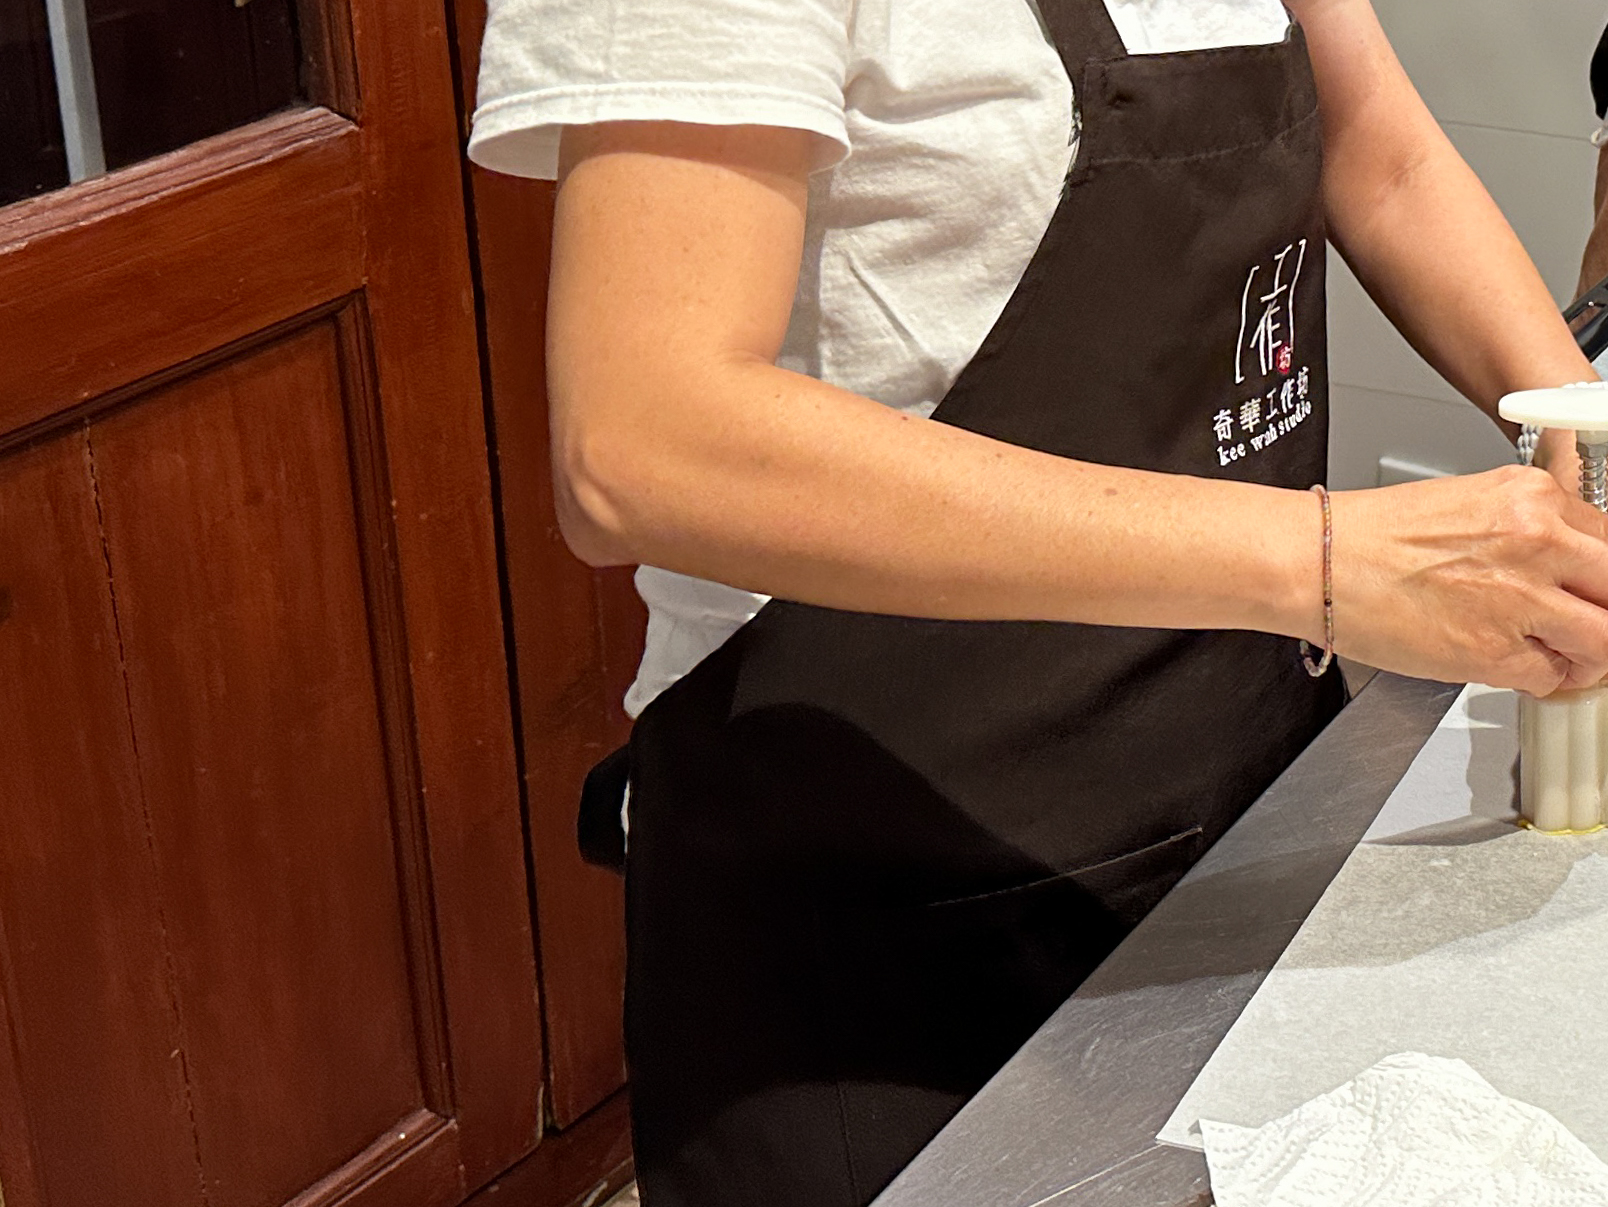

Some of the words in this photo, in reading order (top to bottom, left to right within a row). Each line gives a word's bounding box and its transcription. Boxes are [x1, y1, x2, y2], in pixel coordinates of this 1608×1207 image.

[1216, 442, 1247, 467] kee
[1249, 423, 1279, 453] wah
[1277, 399, 1313, 436] studio
